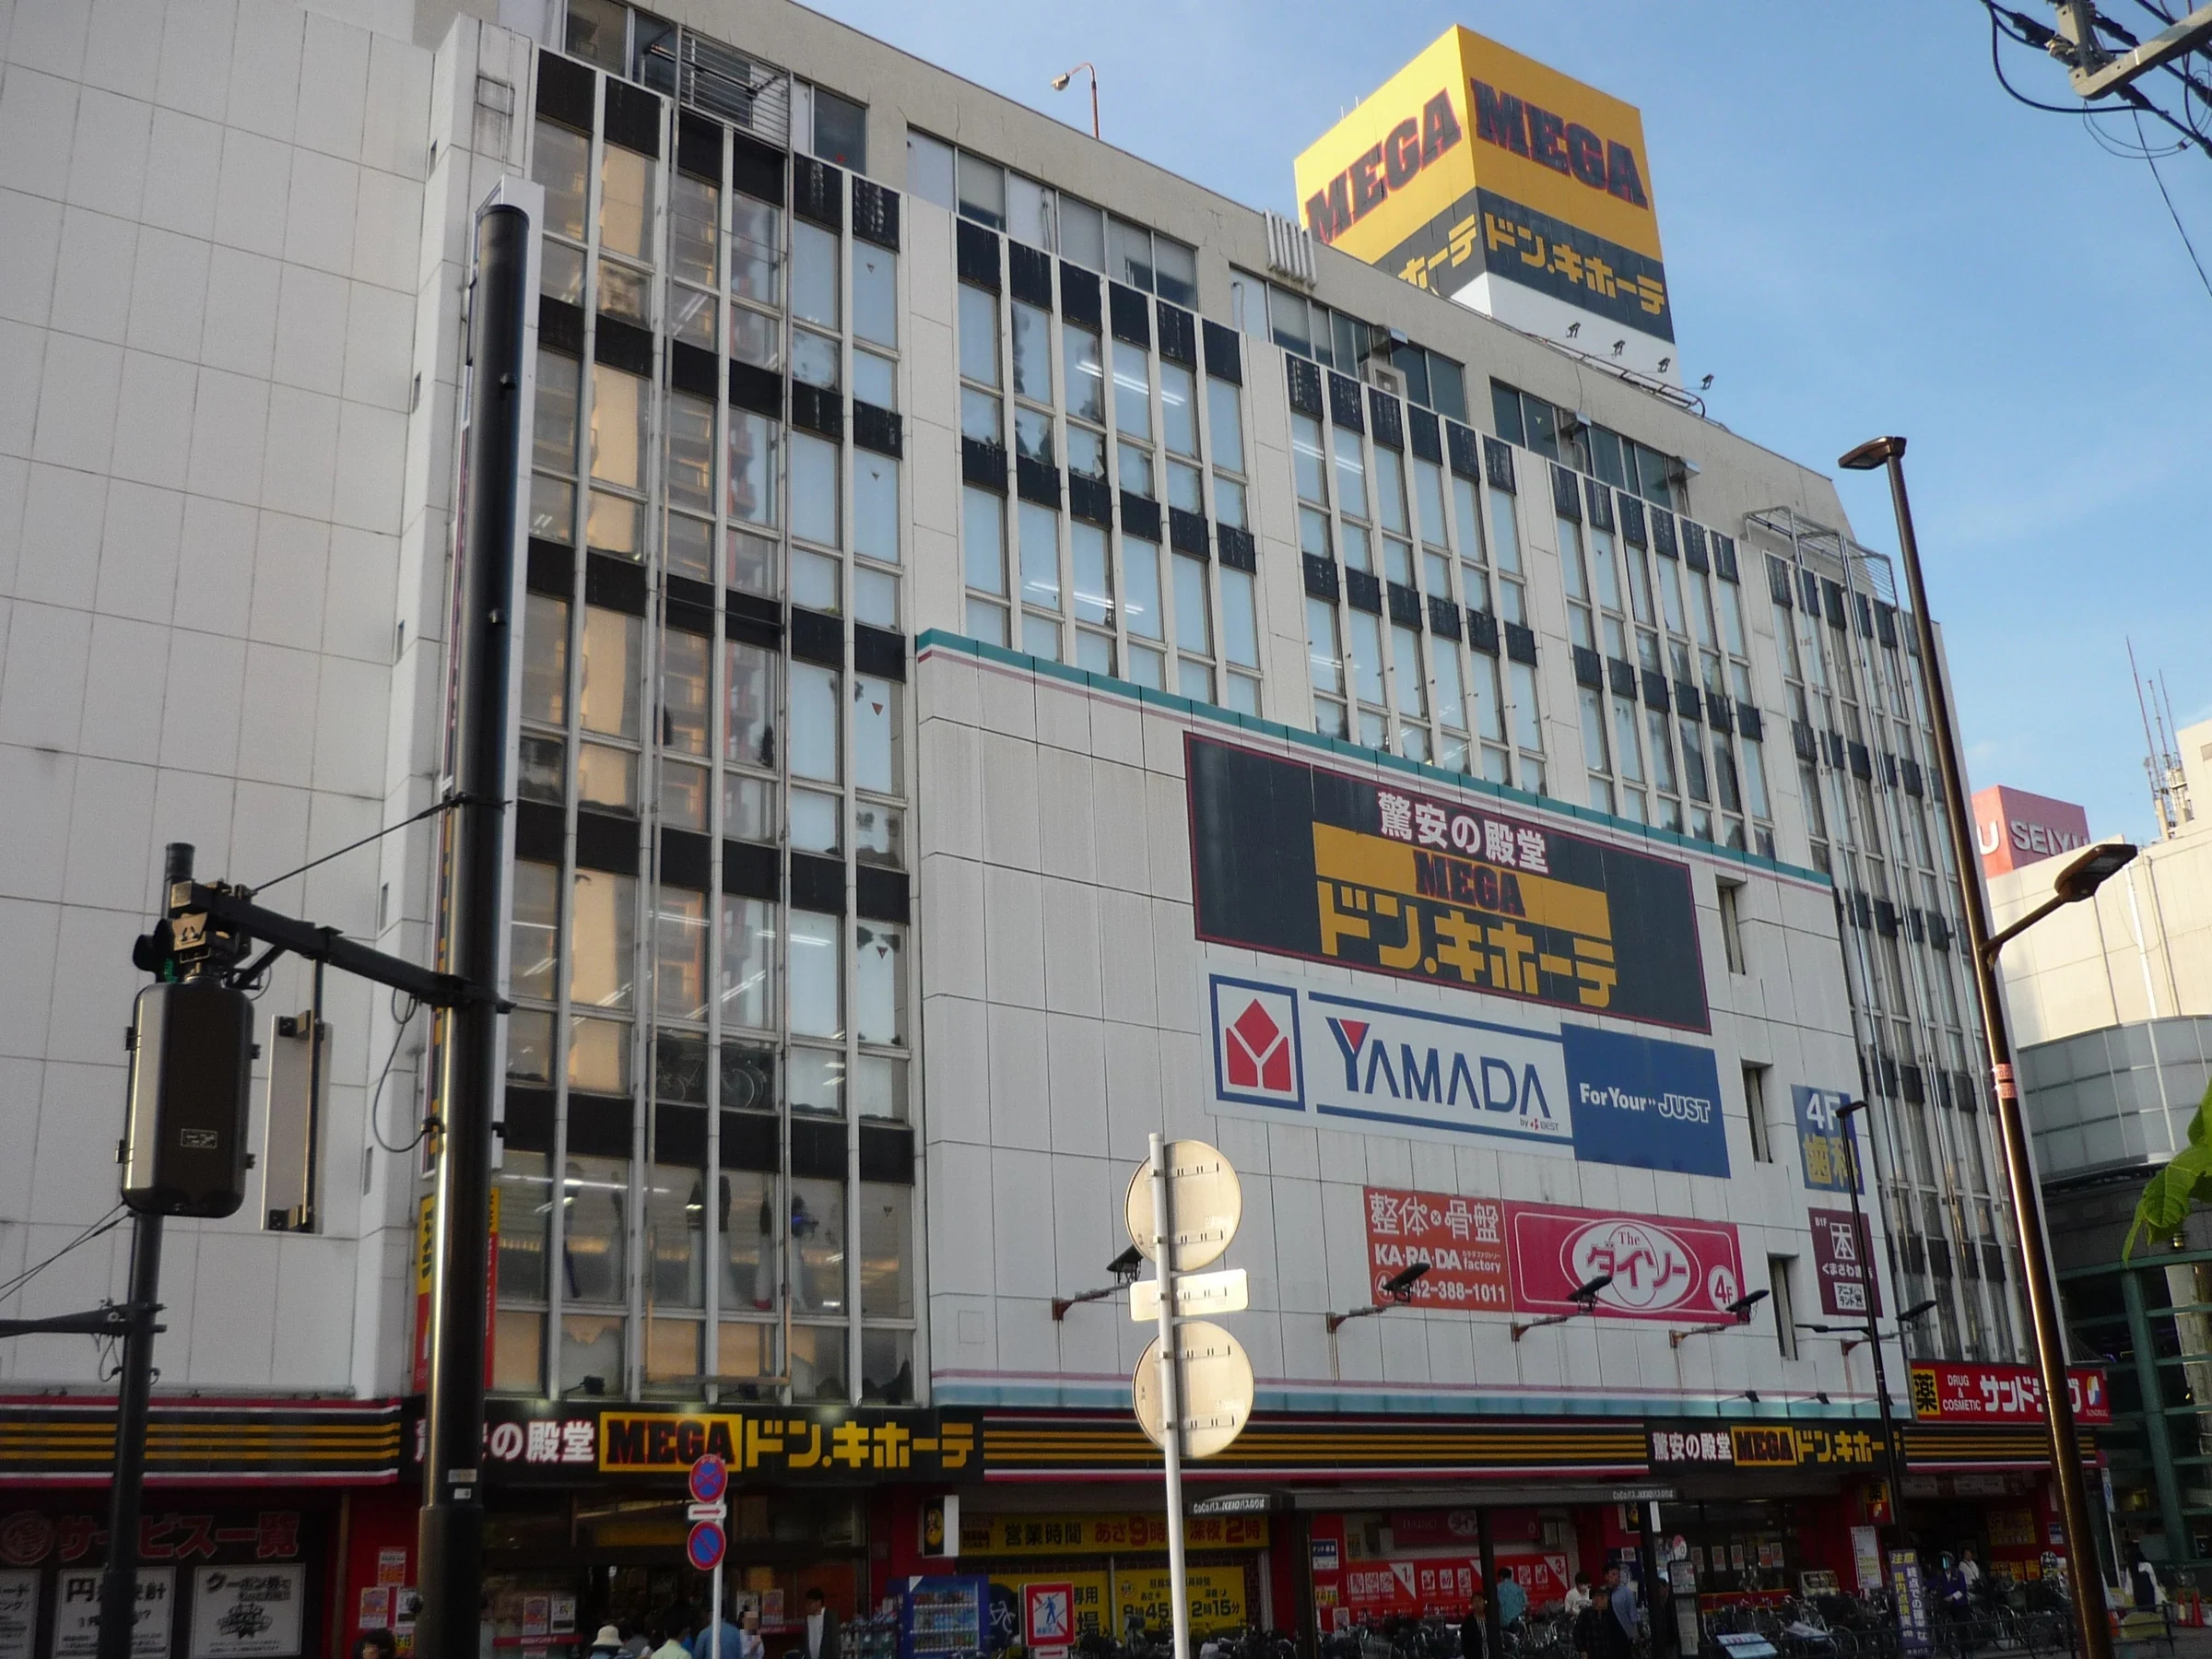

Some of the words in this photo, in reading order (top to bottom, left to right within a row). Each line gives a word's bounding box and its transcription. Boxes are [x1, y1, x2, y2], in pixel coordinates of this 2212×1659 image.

[1470, 76, 1649, 210] MEGA
[1305, 87, 1463, 246] MEGA
[1378, 790, 1548, 875] 驚安の殿堂
[1413, 849, 1527, 918] MEGA
[1325, 1017, 1552, 1119] YAMADA
[1579, 1082, 1607, 1106] For
[1658, 1093, 1712, 1124] JUST
[1806, 1093, 1841, 1132] 4F
[1540, 1120, 1559, 1132] BEST
[1618, 1231, 1641, 1246] The
[1464, 1258, 1501, 1275] factory
[1586, 1239, 1688, 1289] ダイソー
[1714, 1274, 1733, 1305] 4F
[1913, 1373, 1937, 1413] 薬
[1947, 1374, 1971, 1387] DRUG
[1958, 1387, 1965, 1399] &
[1942, 1398, 1982, 1413] COSMETIC
[606, 1418, 737, 1467] MEGA
[1653, 1431, 1733, 1462] 驚安の殿堂
[1735, 1430, 1794, 1462] MEGA
[1005, 1522, 1083, 1547] 営業時間
